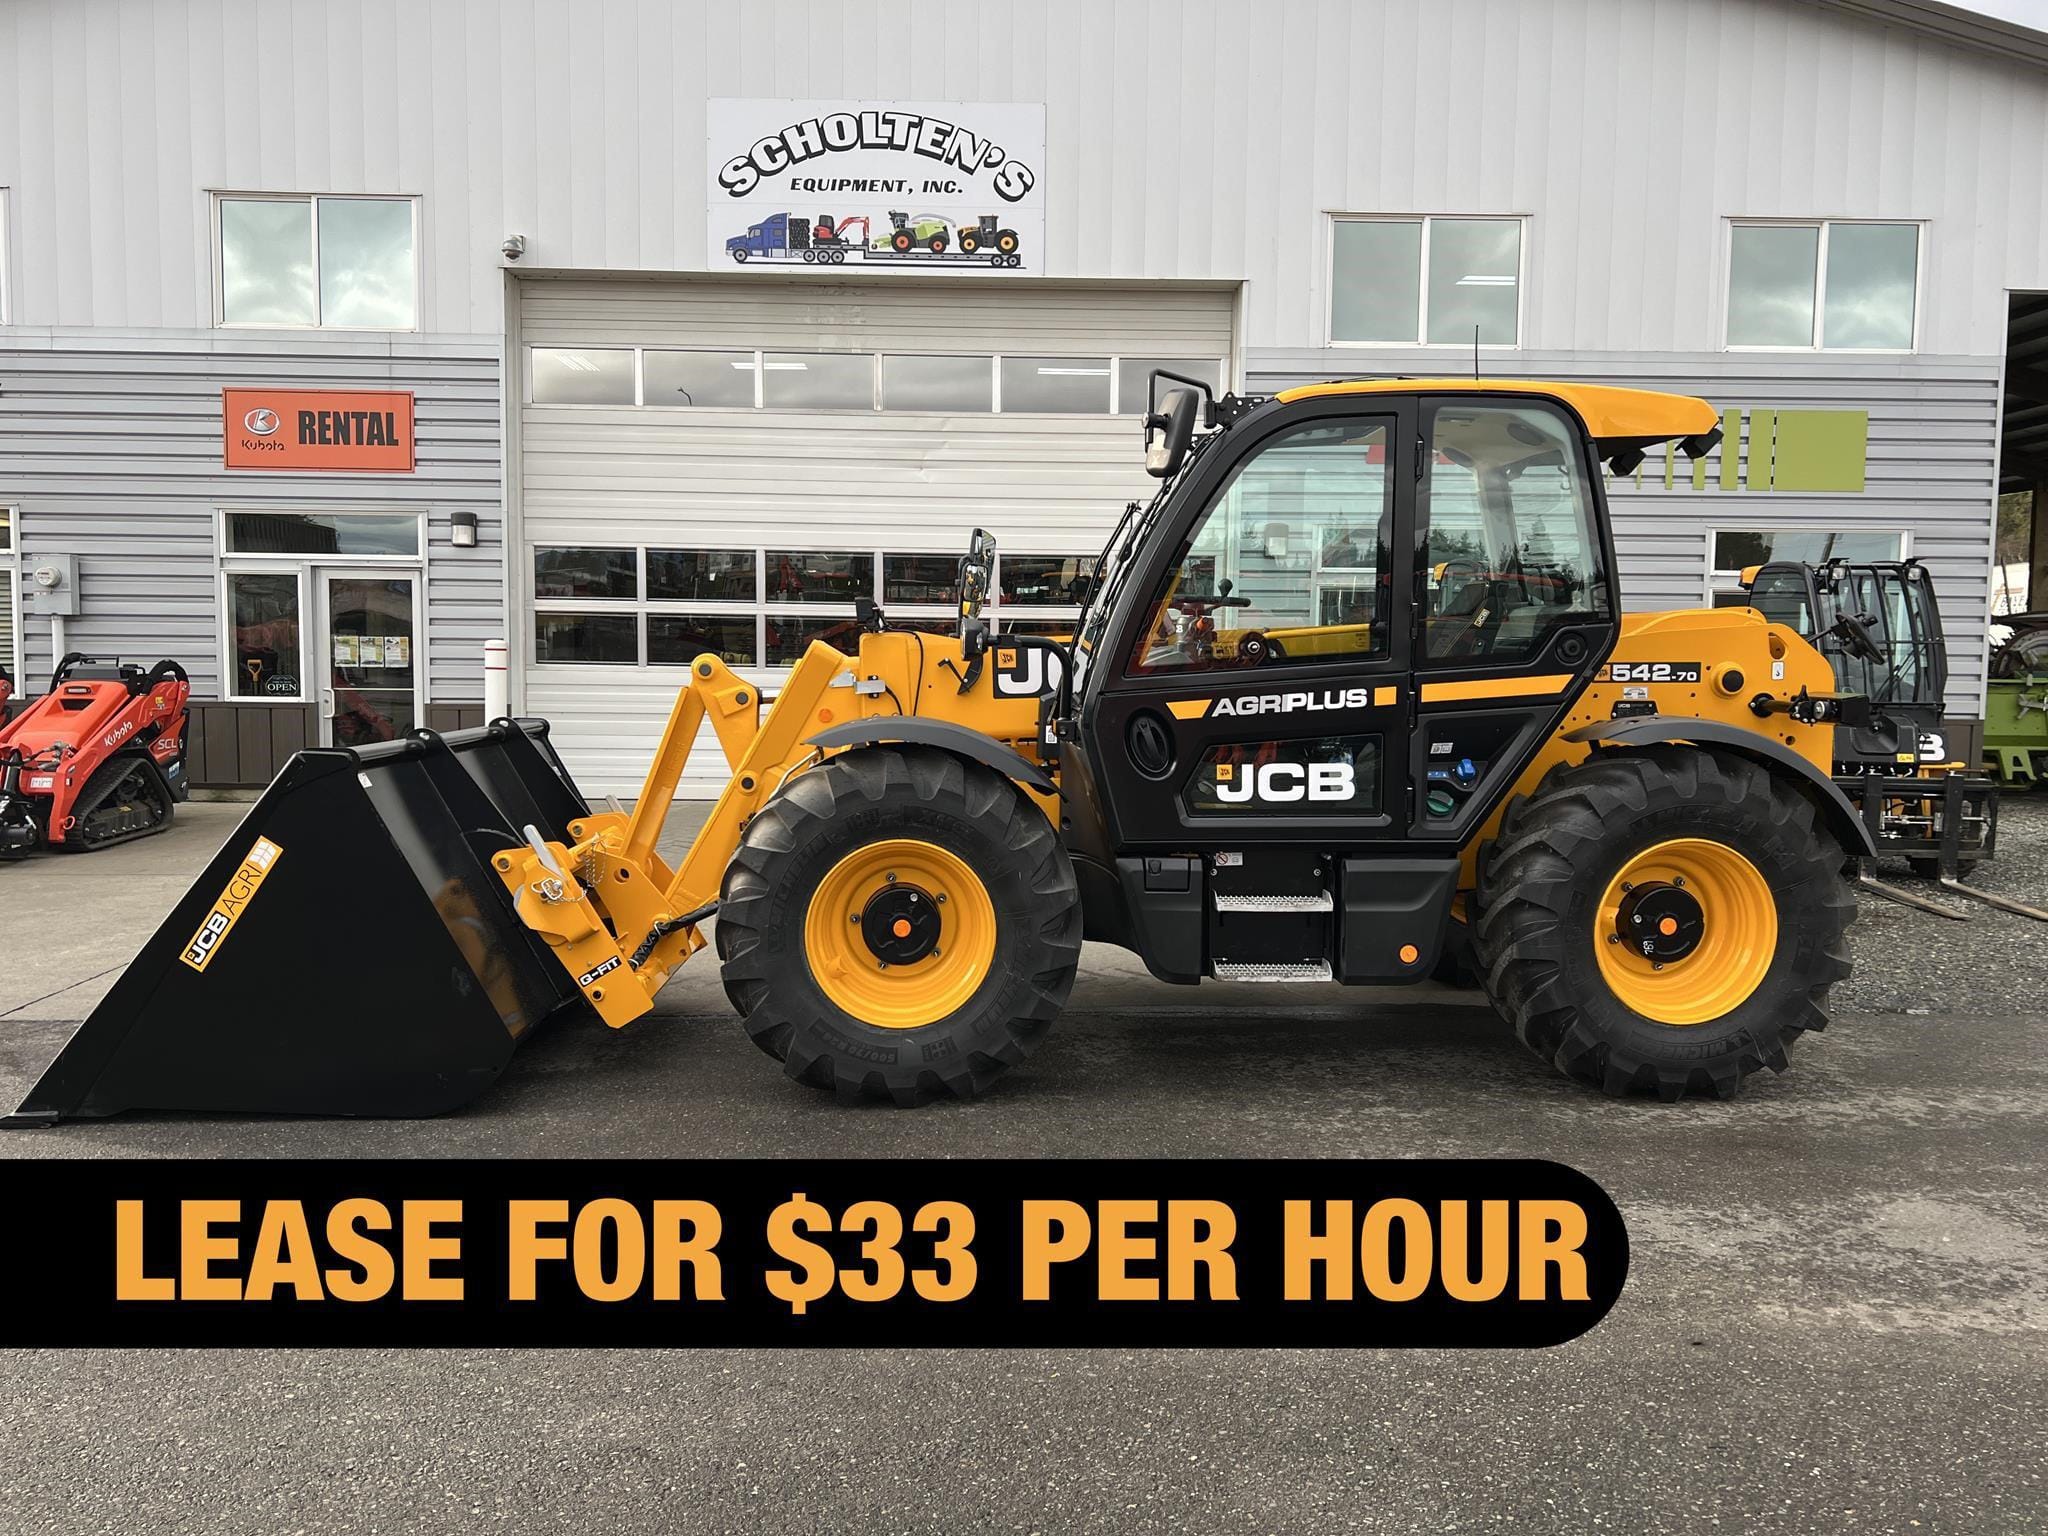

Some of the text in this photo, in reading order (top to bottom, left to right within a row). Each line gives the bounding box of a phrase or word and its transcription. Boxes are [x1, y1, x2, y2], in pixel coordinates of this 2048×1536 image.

[718, 111, 1035, 202] SCHOLTEN'S
[790, 178, 963, 195] EQUIPMENT, INC.
[298, 410, 399, 446] RENTAL
[241, 439, 285, 451] Kubota
[267, 683, 297, 691] OPEN
[1612, 664, 1697, 681] 542-70
[1211, 688, 1367, 718] AGRIPLUS
[104, 721, 133, 746] Kubota
[1216, 763, 1355, 802] JCB
[192, 863, 262, 963] JCB AGRI
[580, 956, 618, 985] Q-FIT
